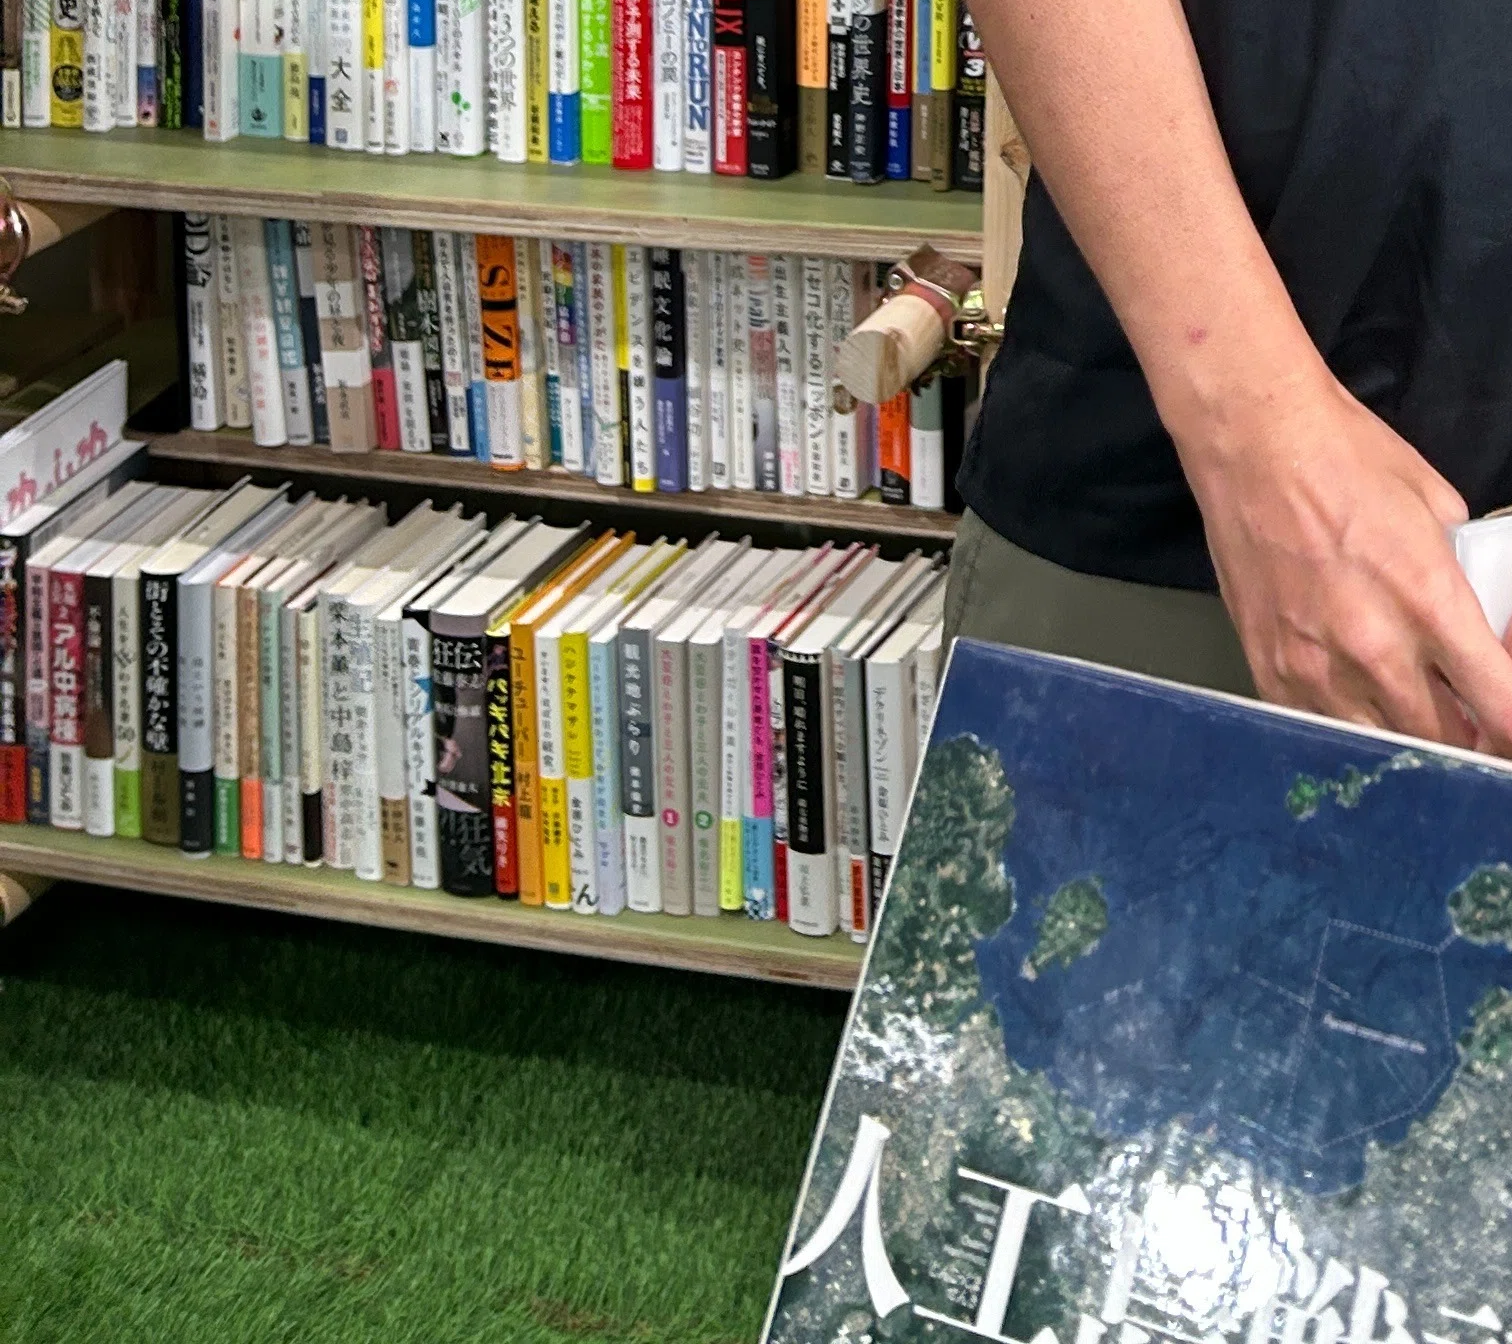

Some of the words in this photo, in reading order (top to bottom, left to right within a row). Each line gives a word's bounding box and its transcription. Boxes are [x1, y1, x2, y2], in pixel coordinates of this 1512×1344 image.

[330, 57, 352, 114] 大全
[687, 56, 710, 130] RUN
[628, 248, 648, 477] エビデンスを嫌う人たち
[143, 580, 169, 753] 街とその不確かな壁
[432, 639, 481, 671] 狂伝
[513, 644, 529, 758] ユーチューバー
